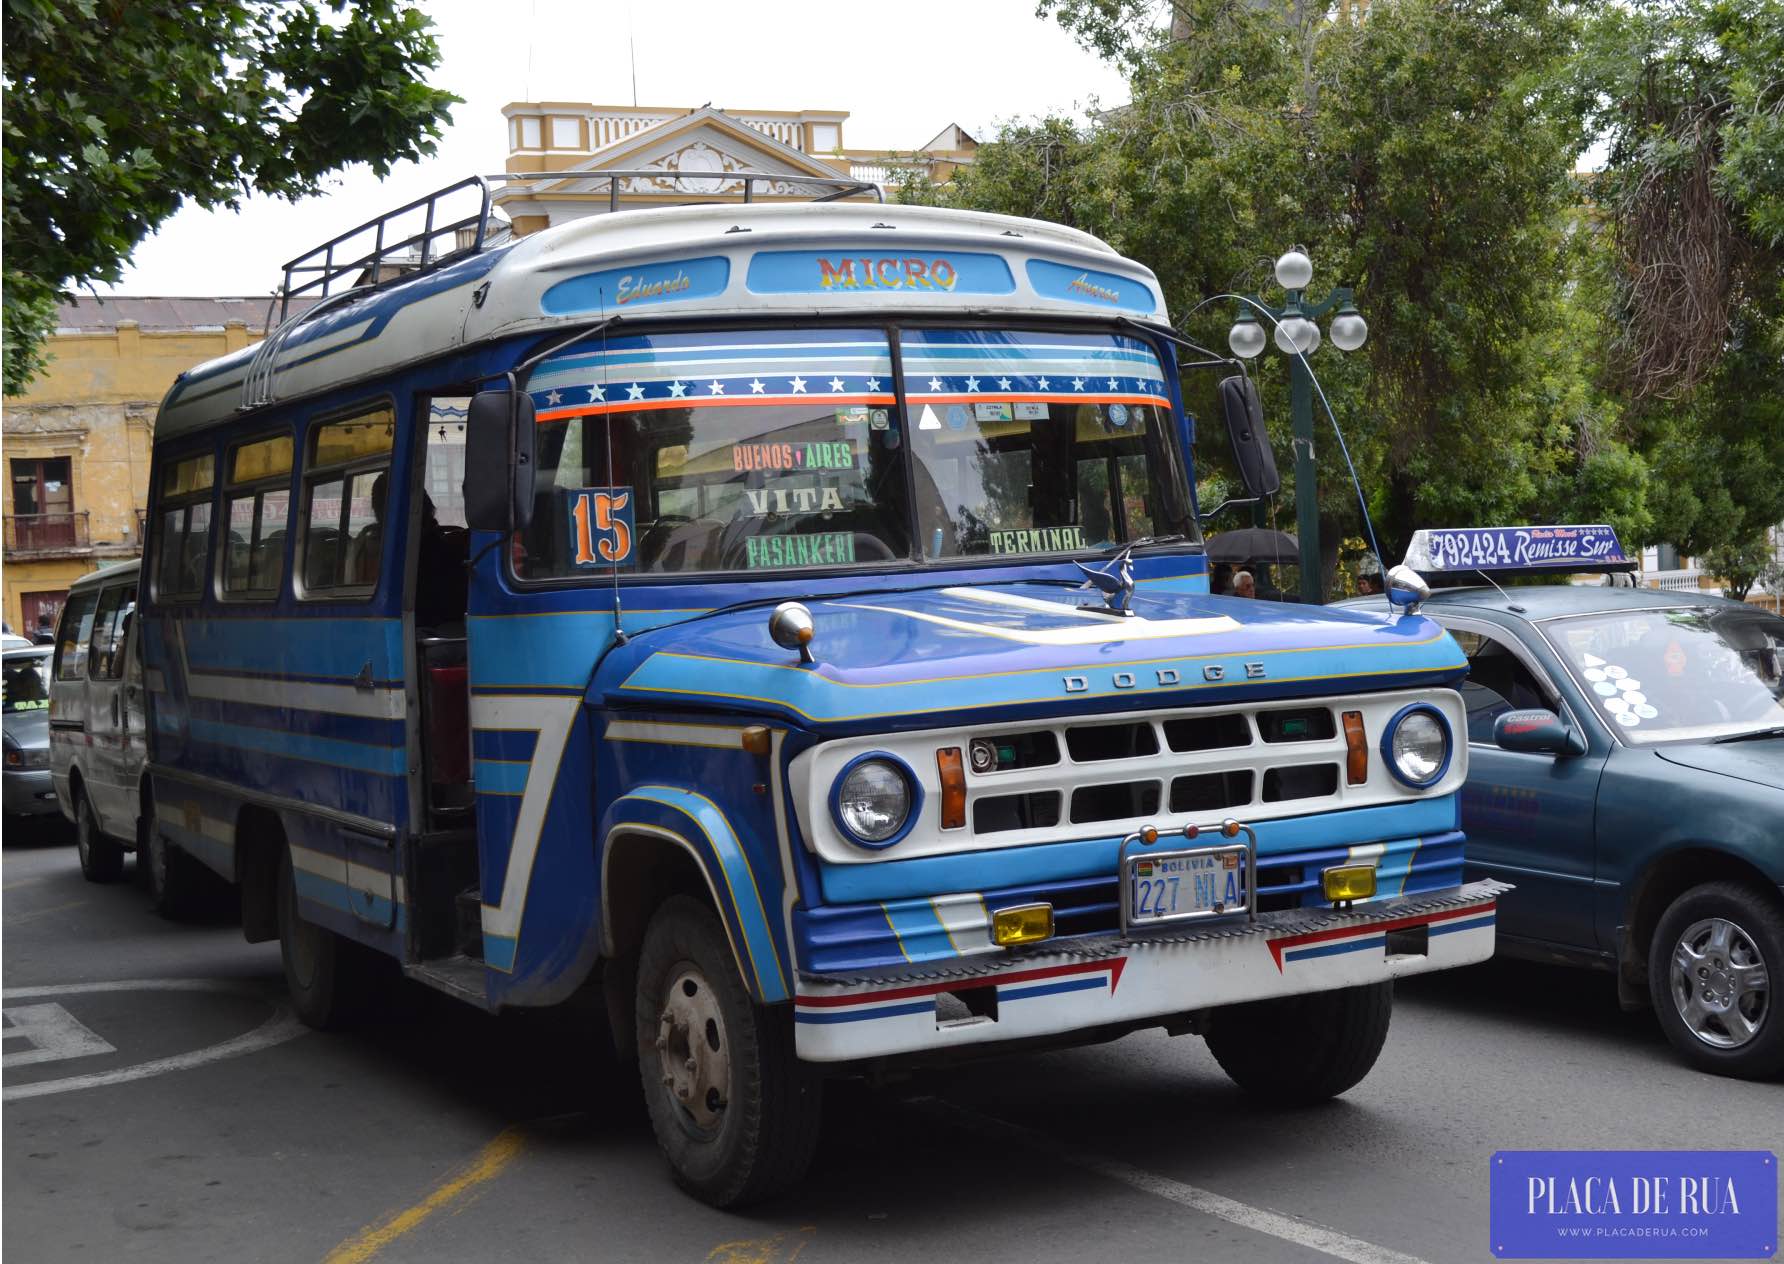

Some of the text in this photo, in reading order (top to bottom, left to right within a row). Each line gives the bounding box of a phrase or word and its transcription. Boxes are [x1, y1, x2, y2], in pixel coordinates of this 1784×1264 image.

[816, 256, 958, 291] MICRO
[733, 442, 853, 471] BUENOS AIRES
[746, 487, 844, 514] VITA
[573, 492, 631, 564] 15
[989, 527, 1086, 554] TERMINAL
[747, 533, 855, 567] PASANKERI
[1432, 532, 1512, 568] 792424
[1514, 530, 1614, 566] Remisse Sur
[1063, 662, 1266, 692] DODGE
[1508, 714, 1551, 722] Castrol
[1161, 857, 1215, 873] BOLIVIA
[1139, 871, 1238, 914] 227 NLA
